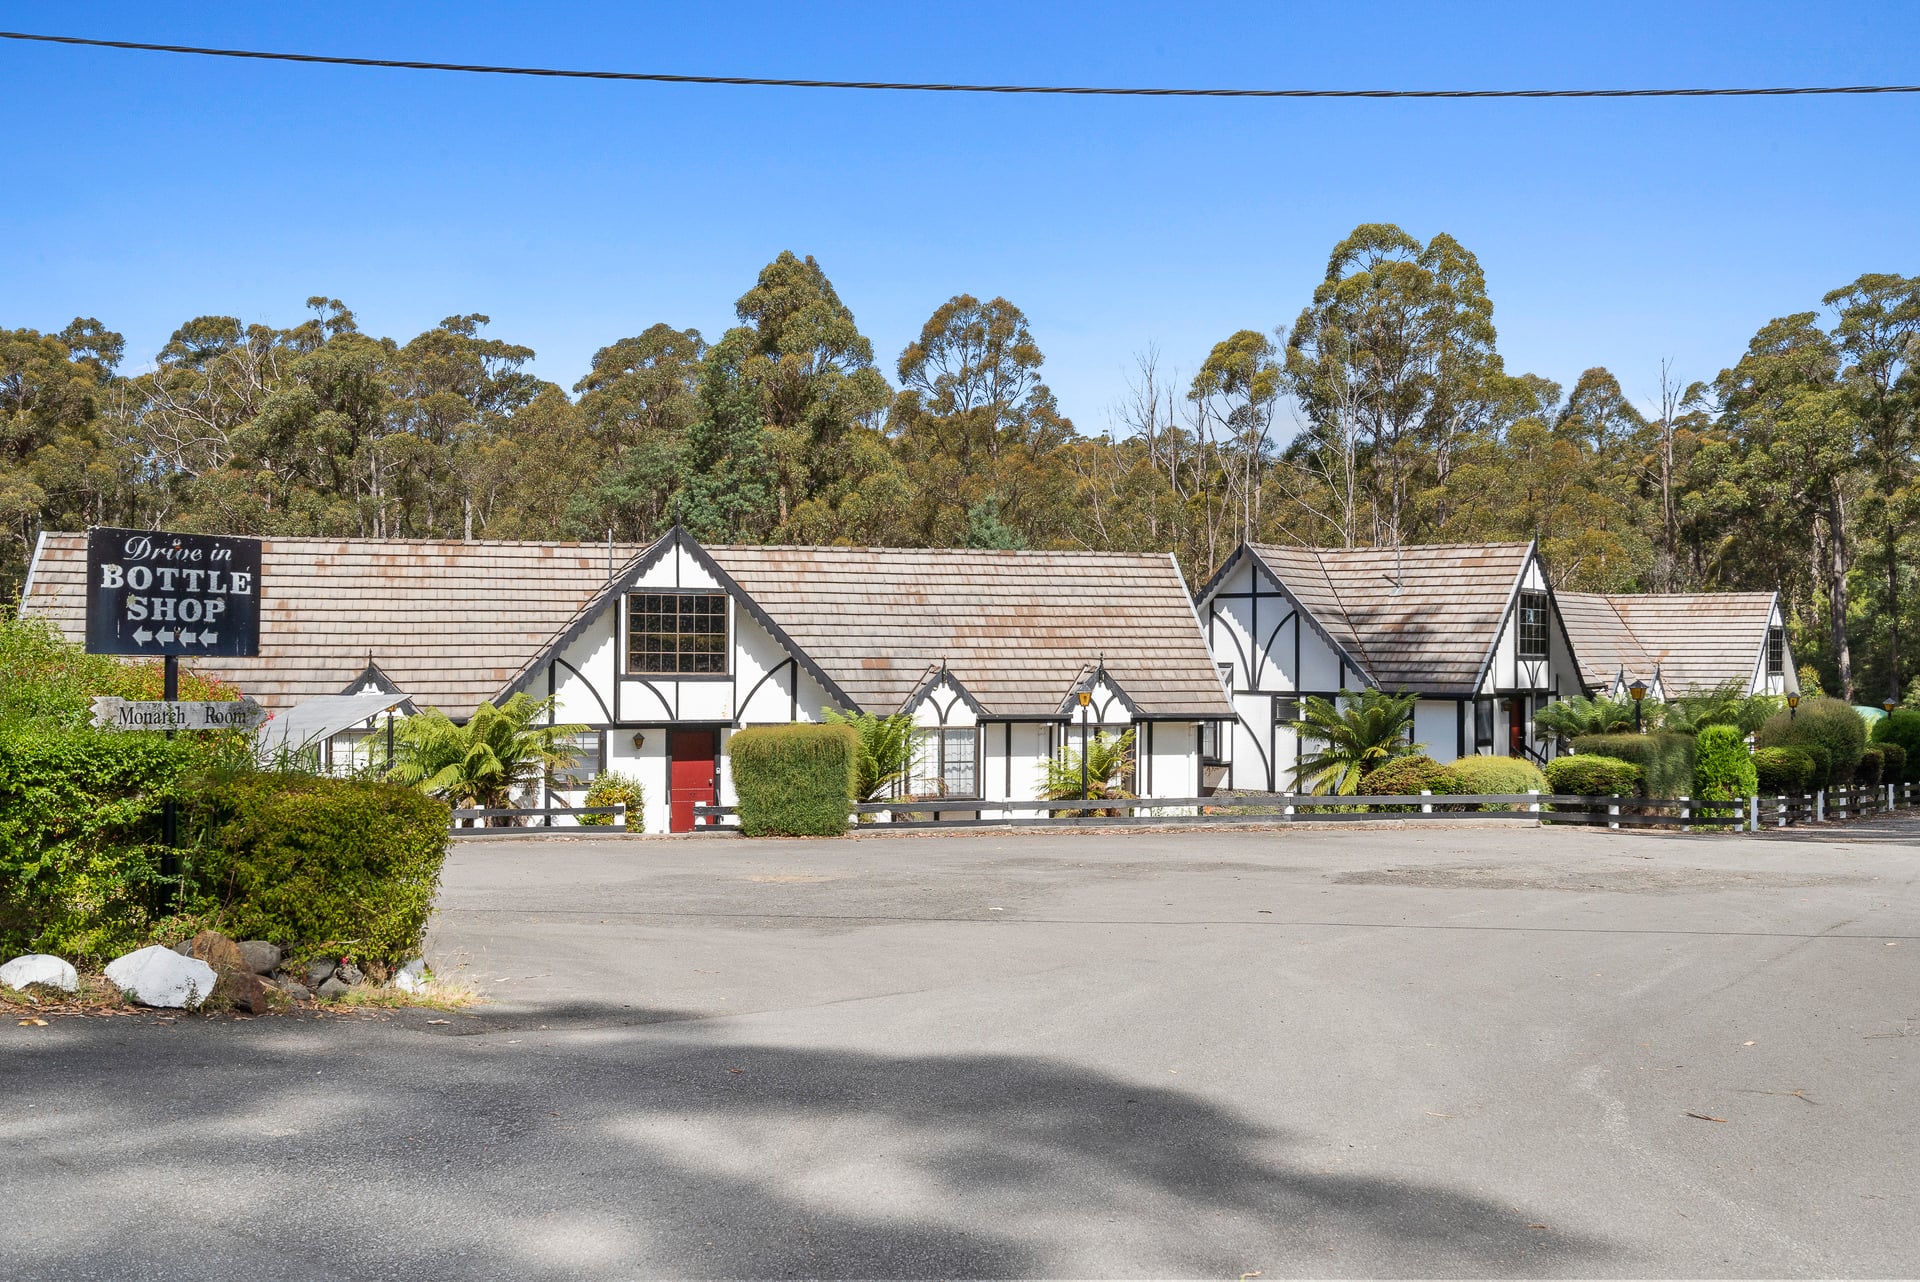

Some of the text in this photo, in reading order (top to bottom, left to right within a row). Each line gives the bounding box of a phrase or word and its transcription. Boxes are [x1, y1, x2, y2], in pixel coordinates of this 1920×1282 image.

[123, 535, 233, 562] Drive in
[100, 563, 252, 595] BOTTLE
[127, 596, 226, 623] SHOP
[118, 705, 247, 725] Monarch Room
